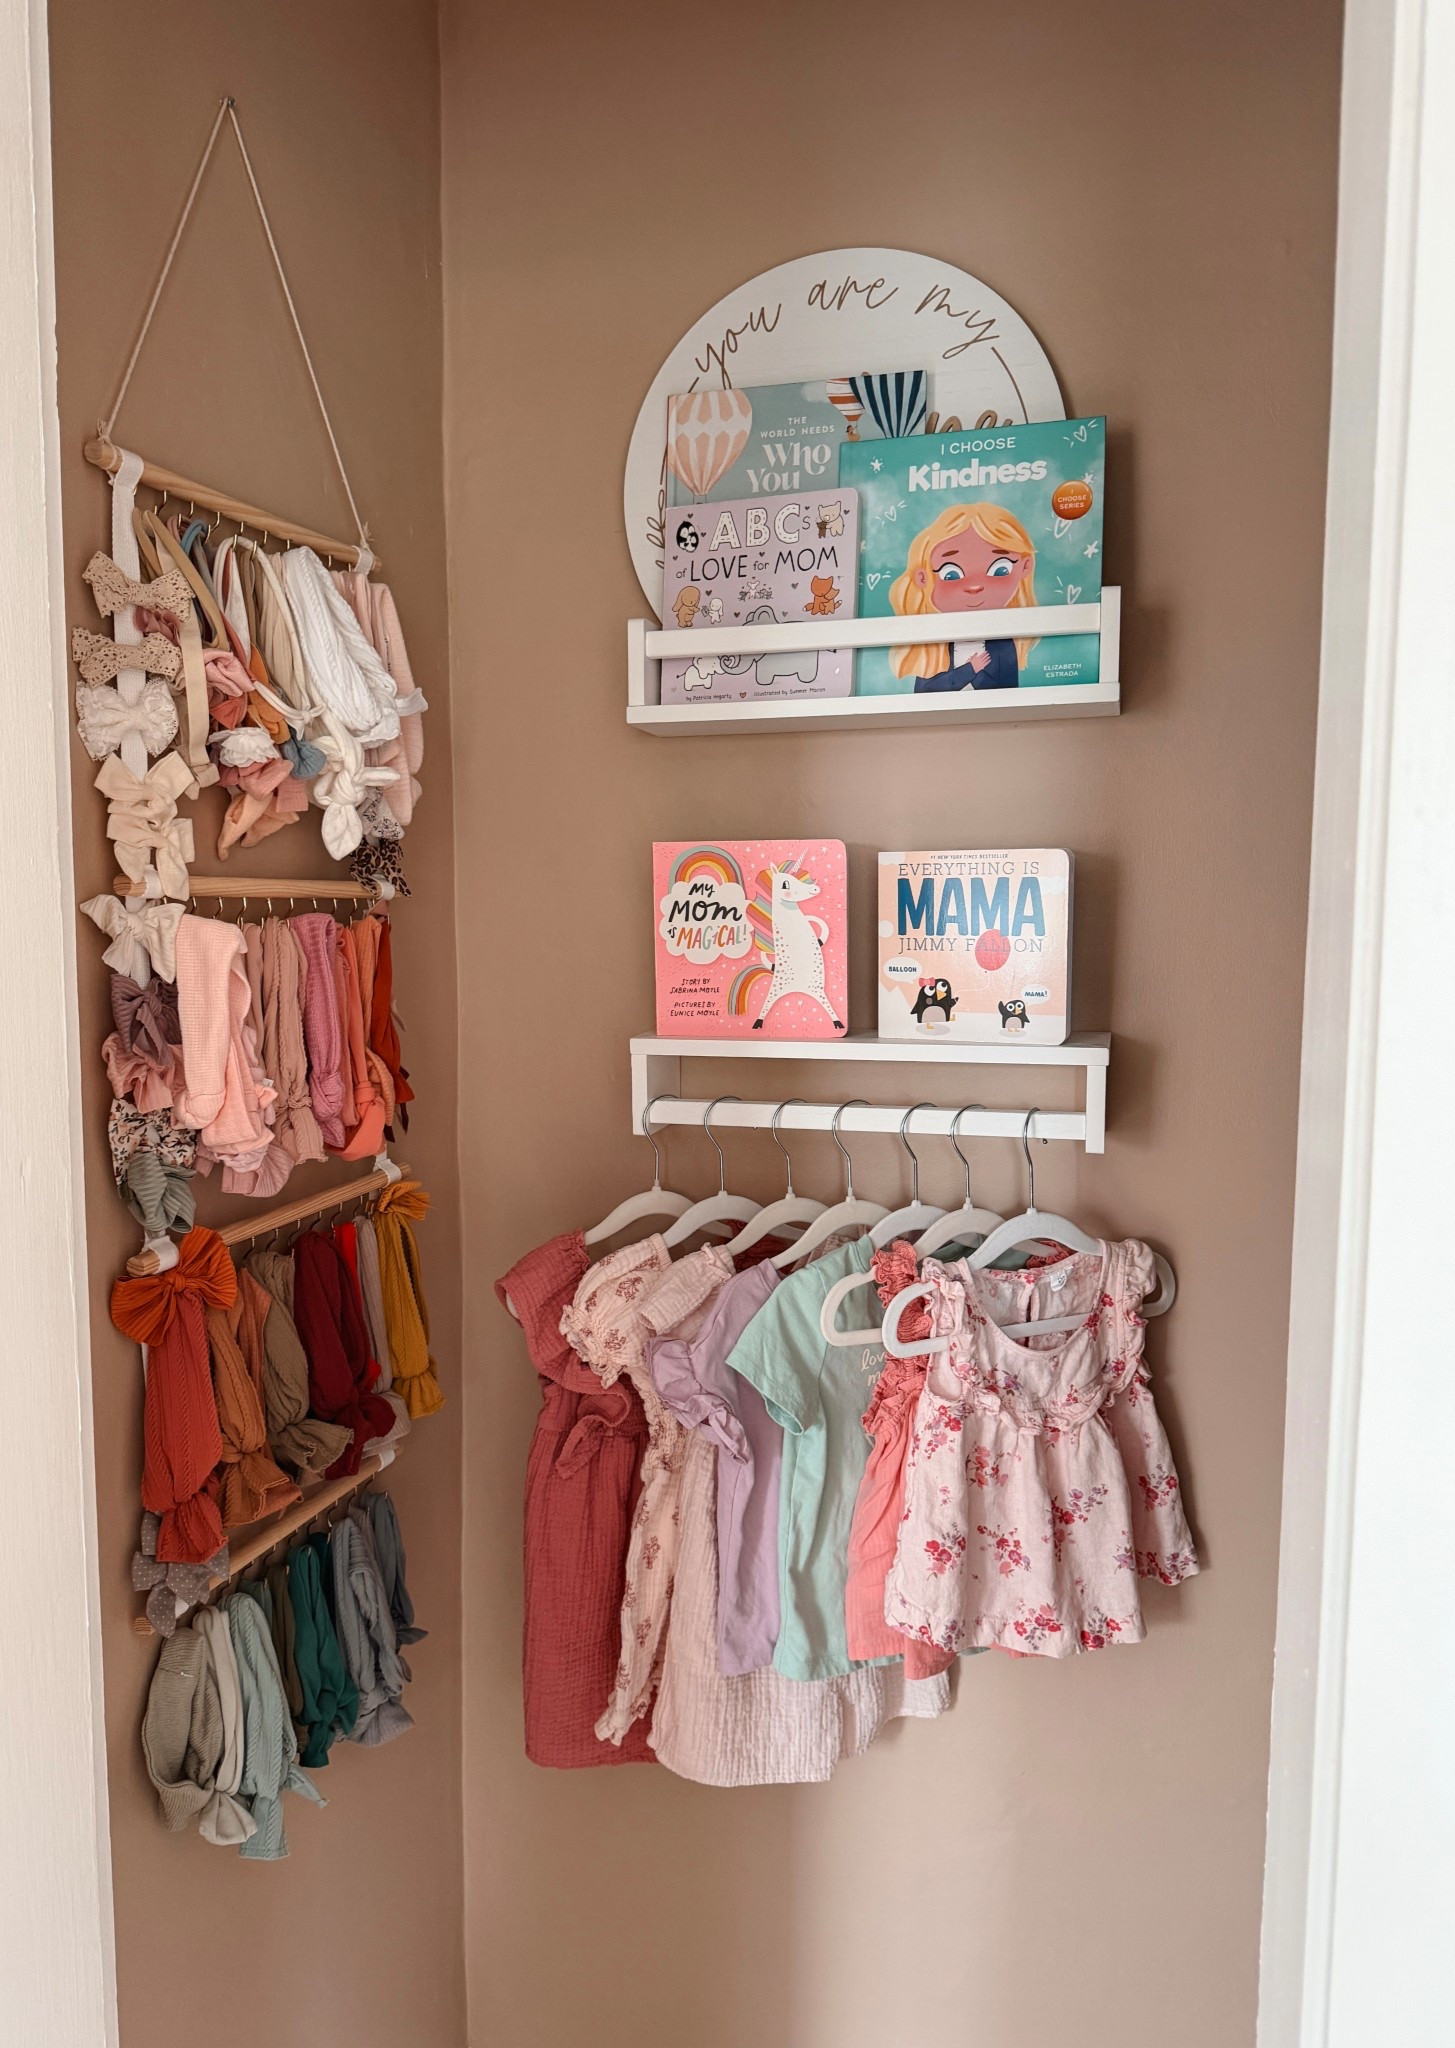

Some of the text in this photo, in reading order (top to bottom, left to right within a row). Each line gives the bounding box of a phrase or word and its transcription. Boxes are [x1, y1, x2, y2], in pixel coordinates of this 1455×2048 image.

[695, 275, 1000, 390] you are my
[787, 416, 808, 426] THE
[760, 425, 836, 439] WORLD NEEDS
[940, 436, 1017, 456] I CHOOSE
[761, 441, 833, 476] Who
[746, 467, 801, 493] You
[908, 458, 1048, 493] Kindness
[1057, 494, 1088, 503] CHOOSE
[1059, 502, 1085, 510] SERIES
[675, 545, 839, 582] of LOVE for MOM
[1043, 663, 1082, 671] ELIZABETH
[1045, 670, 1079, 678] ESTRADA
[898, 861, 1040, 876] EVERYTHING IS
[688, 883, 716, 898] My
[897, 877, 1046, 937] MAMA
[898, 937, 957, 954] JIMMY
[888, 965, 917, 973] BALLOON
[681, 978, 701, 986] STORY
[669, 986, 720, 994] SABRINA MOYLE
[670, 1009, 720, 1017] EUNICE MOYLE
[860, 1348, 886, 1372] lov
